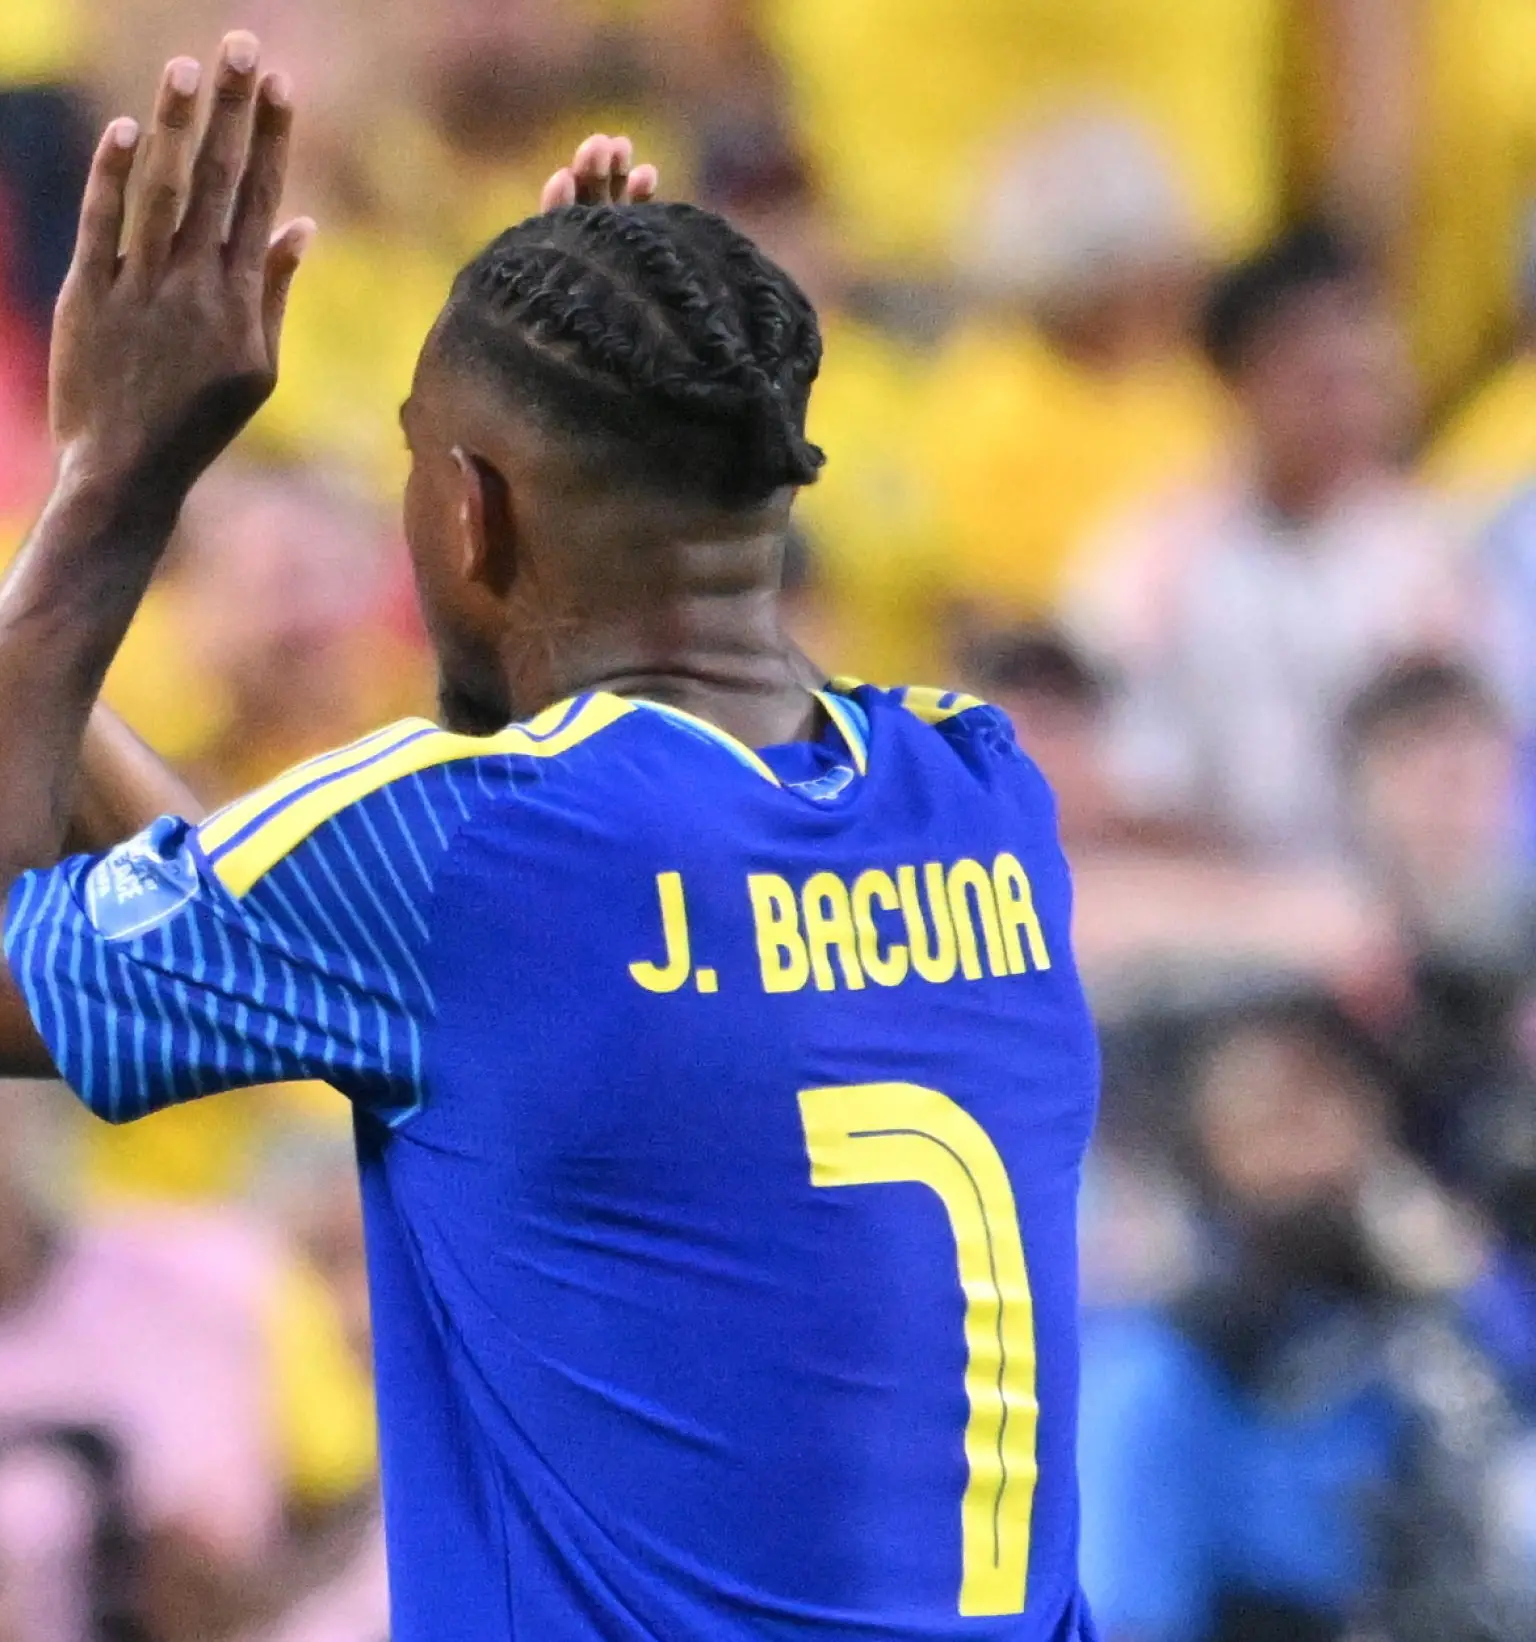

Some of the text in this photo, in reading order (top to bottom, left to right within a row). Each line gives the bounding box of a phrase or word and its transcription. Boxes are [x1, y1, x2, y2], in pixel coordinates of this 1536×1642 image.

[628, 851, 1052, 994] J. BACUNA
[797, 1082, 1039, 1617] 7
